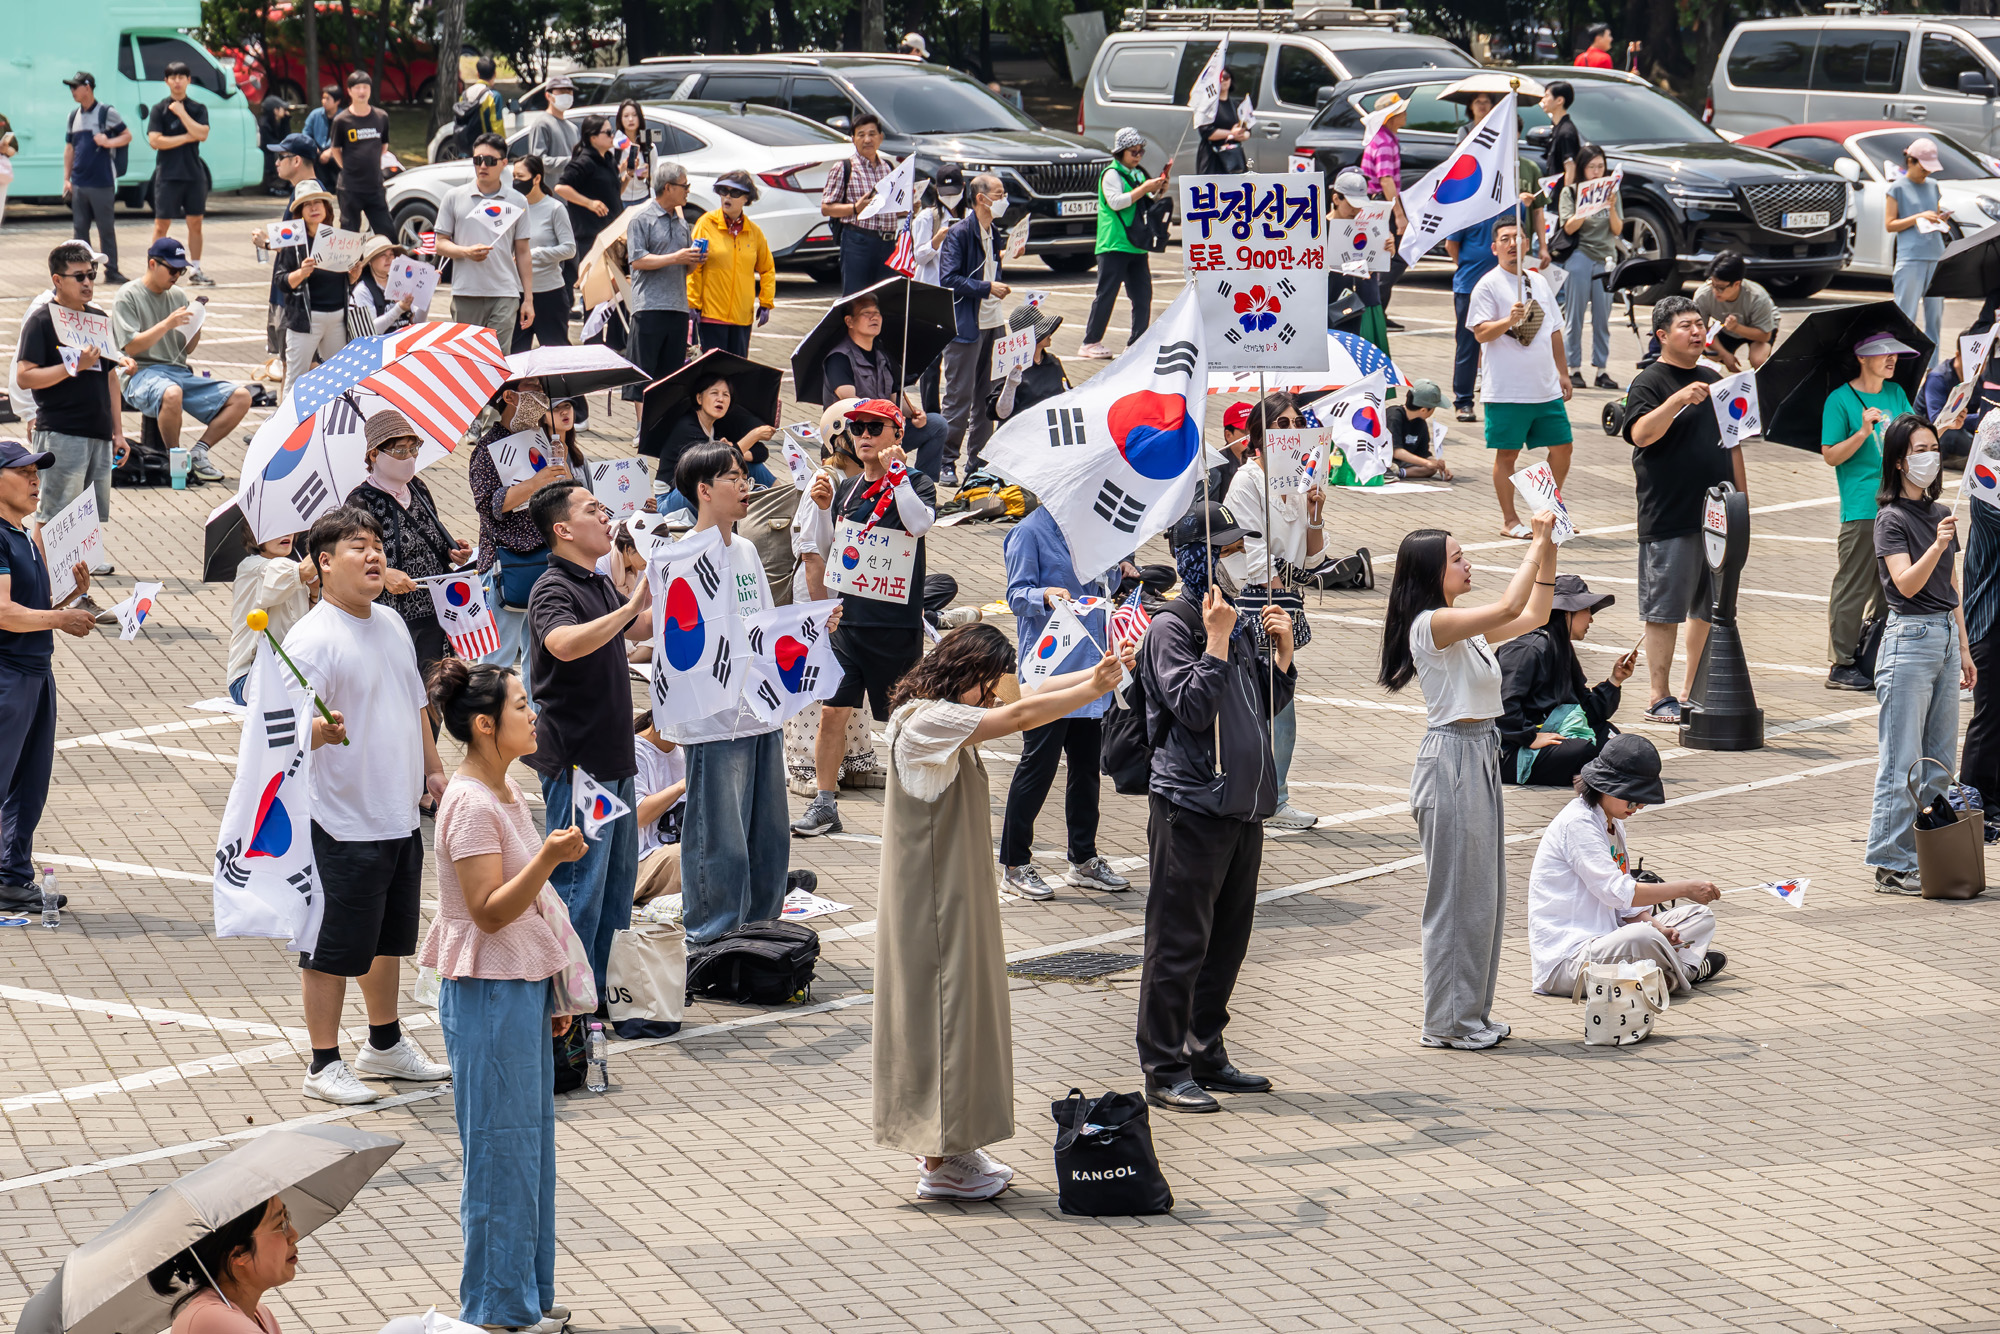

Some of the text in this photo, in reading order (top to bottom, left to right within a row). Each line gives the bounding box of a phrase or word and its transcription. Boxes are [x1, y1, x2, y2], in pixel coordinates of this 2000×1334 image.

[1187, 182, 1321, 241] 부정선거
[58, 308, 109, 336] 부정선거
[1266, 342, 1278, 351] D-8
[1267, 433, 1301, 453] 부정선거
[47, 512, 76, 548] 당일투표
[53, 546, 81, 584] 부정선거
[852, 573, 906, 599] 수개표
[1595, 985, 1603, 995] 6
[1613, 986, 1622, 998] 9
[1593, 1013, 1650, 1026] 0 3 6
[1613, 1035, 1621, 1045] 7
[1631, 1030, 1640, 1039] 5
[1072, 1166, 1137, 1181] KANGOL
